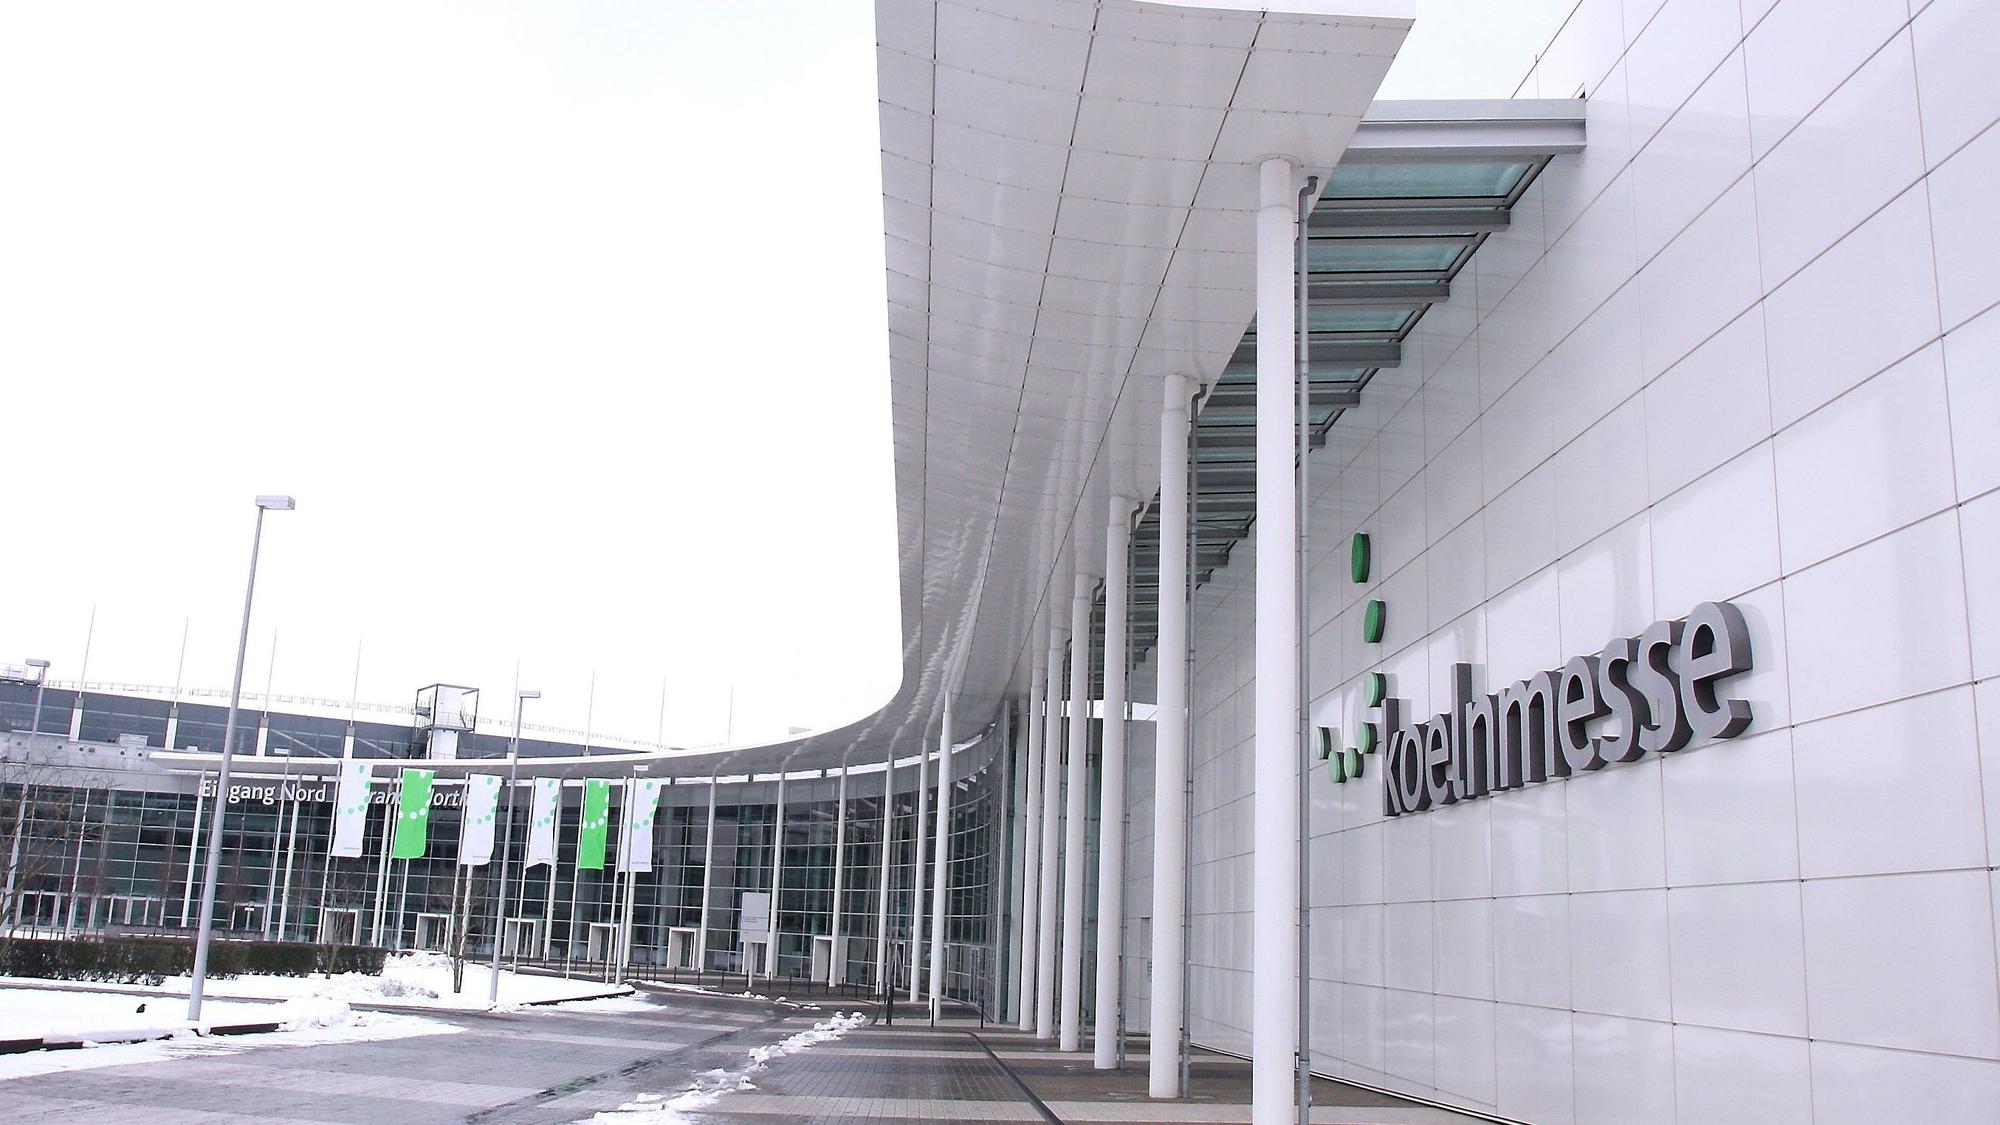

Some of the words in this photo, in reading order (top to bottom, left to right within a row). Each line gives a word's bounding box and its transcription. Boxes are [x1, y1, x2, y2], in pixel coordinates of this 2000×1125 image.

[1381, 601, 1753, 816] koelnmesse
[201, 780, 275, 805] Eigang
[281, 783, 327, 802] Nord
